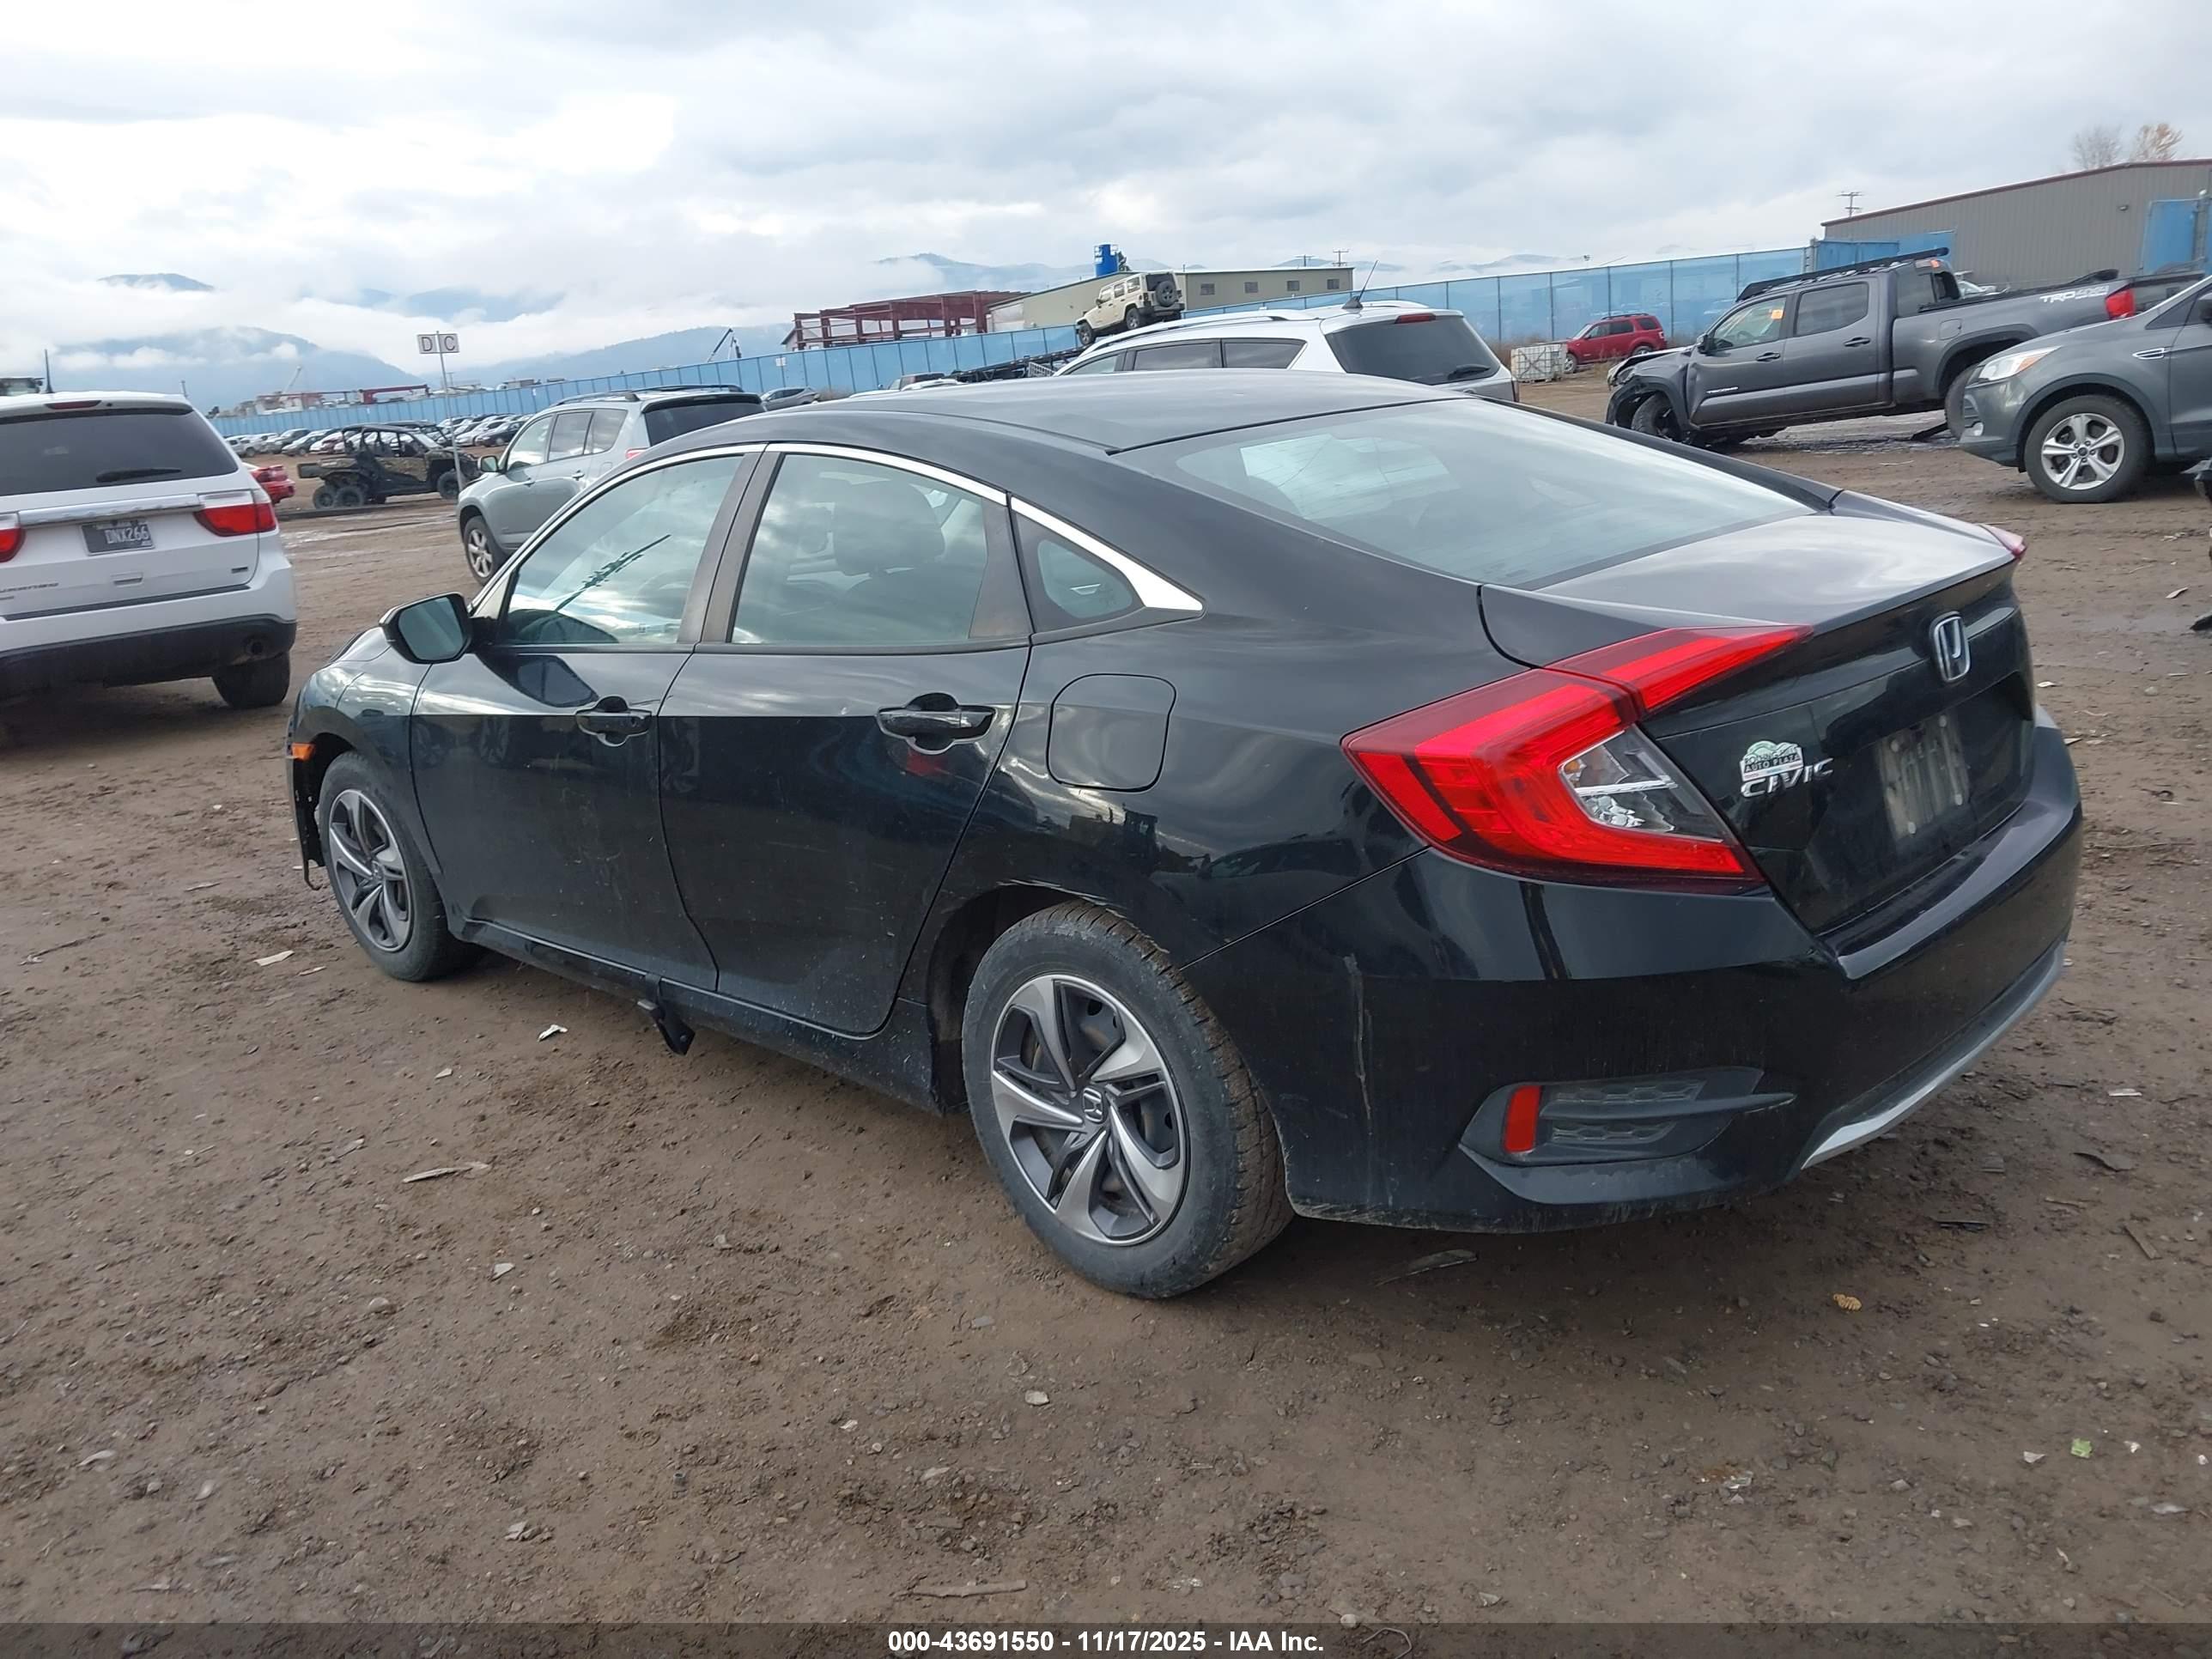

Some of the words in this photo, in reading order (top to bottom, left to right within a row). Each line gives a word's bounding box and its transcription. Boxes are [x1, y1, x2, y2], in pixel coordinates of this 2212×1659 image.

[422, 336, 433, 352] D
[444, 336, 456, 351] C
[1745, 760, 1771, 772] AUTO
[1773, 755, 1800, 766] PLAZA
[1741, 757, 1834, 798] CIVIC
